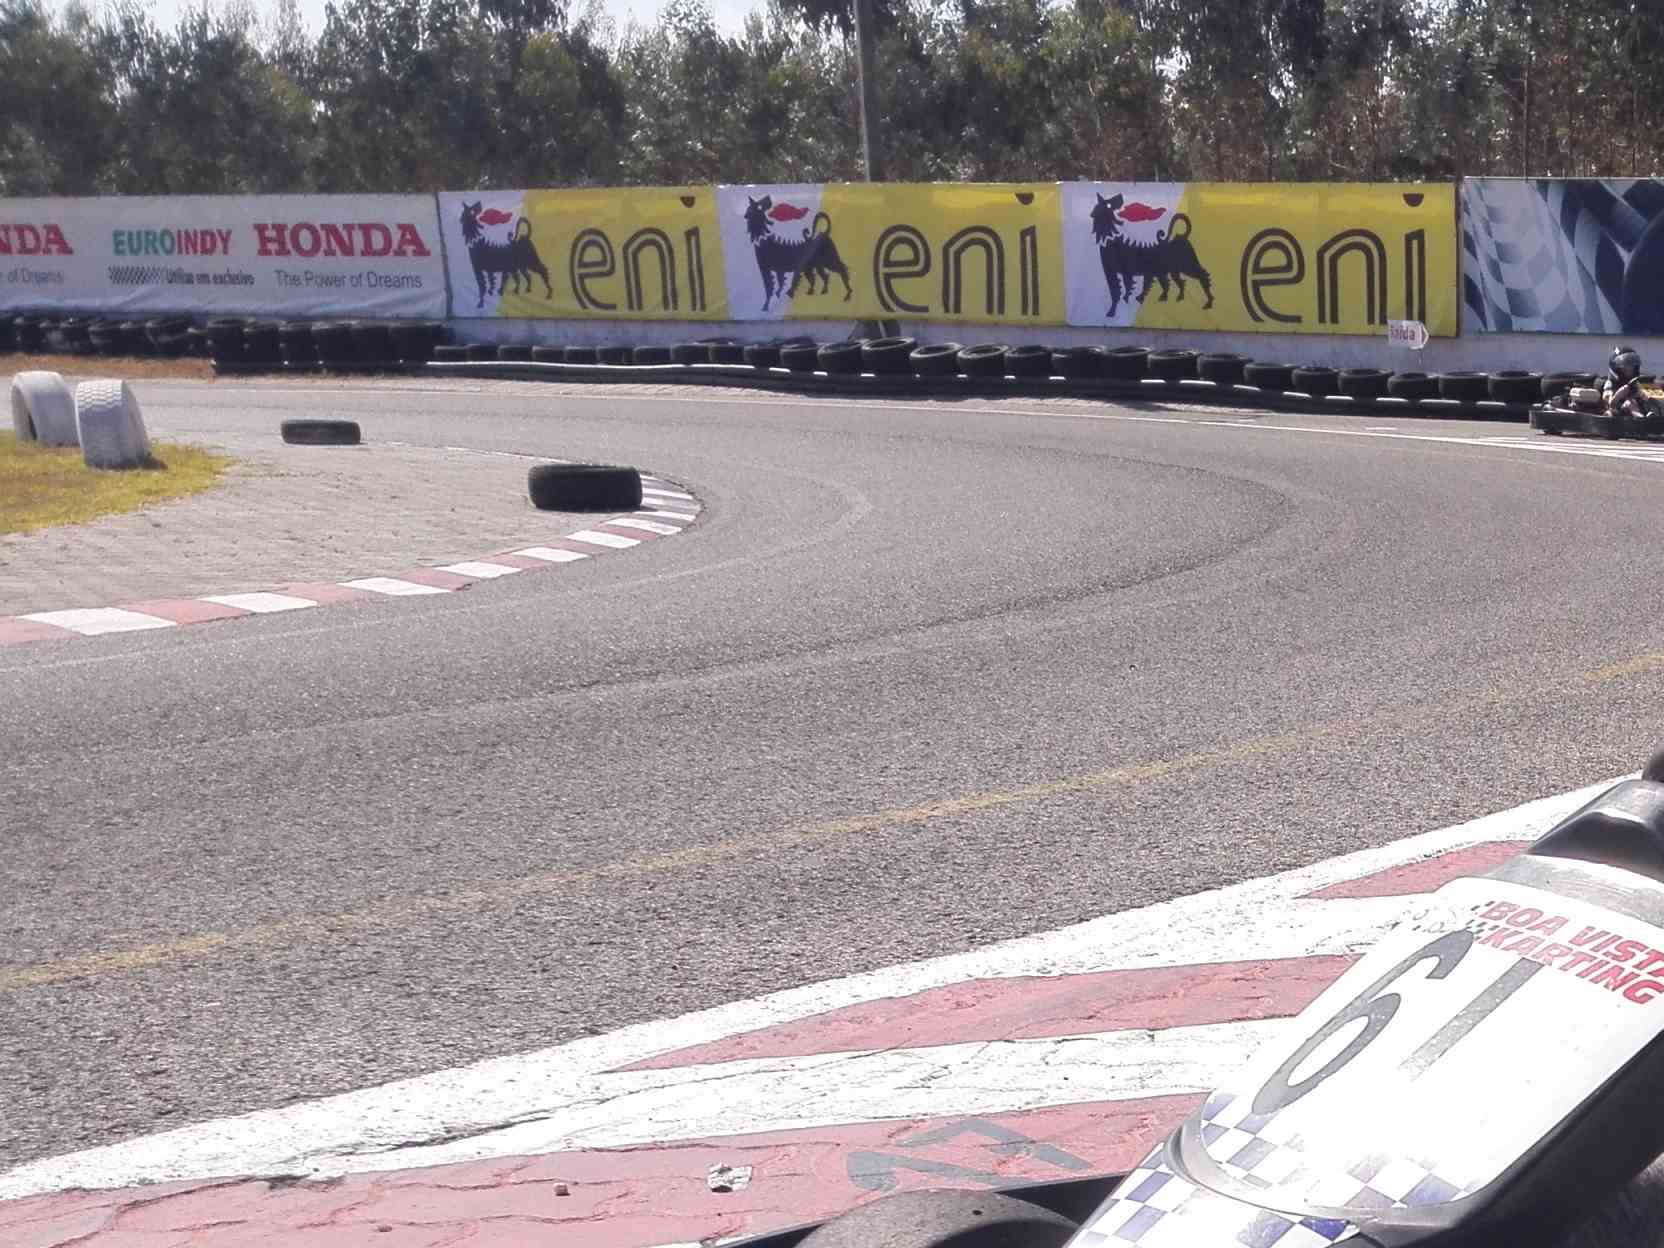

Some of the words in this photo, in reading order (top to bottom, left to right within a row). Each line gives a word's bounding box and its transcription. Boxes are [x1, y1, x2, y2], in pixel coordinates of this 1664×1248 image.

[112, 229, 232, 255] EUROINDY
[253, 221, 431, 257] HONDA
[274, 270, 300, 287] The
[304, 271, 346, 288] Power
[349, 272, 362, 288] of
[367, 272, 422, 288] Dreams
[570, 196, 706, 311] eni
[873, 193, 1039, 315] eni
[1240, 193, 1425, 326] eni
[1480, 900, 1570, 946] BOA
[1252, 930, 1545, 1113] 61
